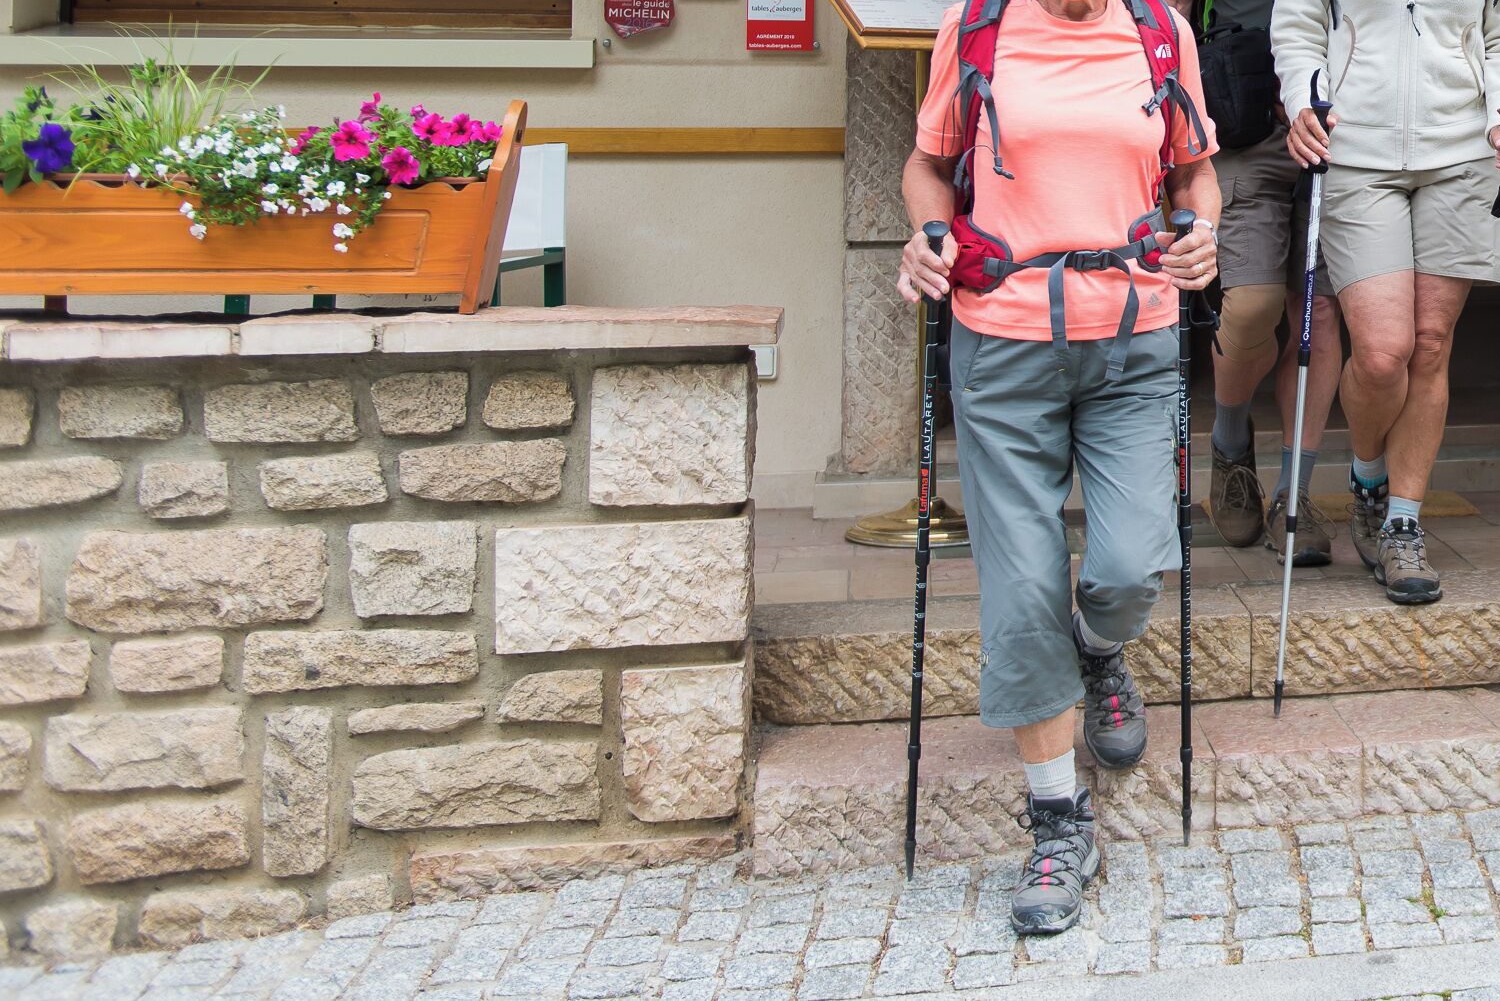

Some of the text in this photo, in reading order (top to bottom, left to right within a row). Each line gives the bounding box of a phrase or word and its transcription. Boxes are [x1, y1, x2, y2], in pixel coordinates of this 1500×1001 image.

[608, 8, 670, 19] MICHELIN
[633, 0, 641, 7] le
[643, 0, 670, 9] guide
[775, 5, 802, 14] auberges
[1302, 299, 1312, 341] Quechua
[923, 393, 933, 460] LAUTARET
[919, 477, 929, 512] Lafuma
